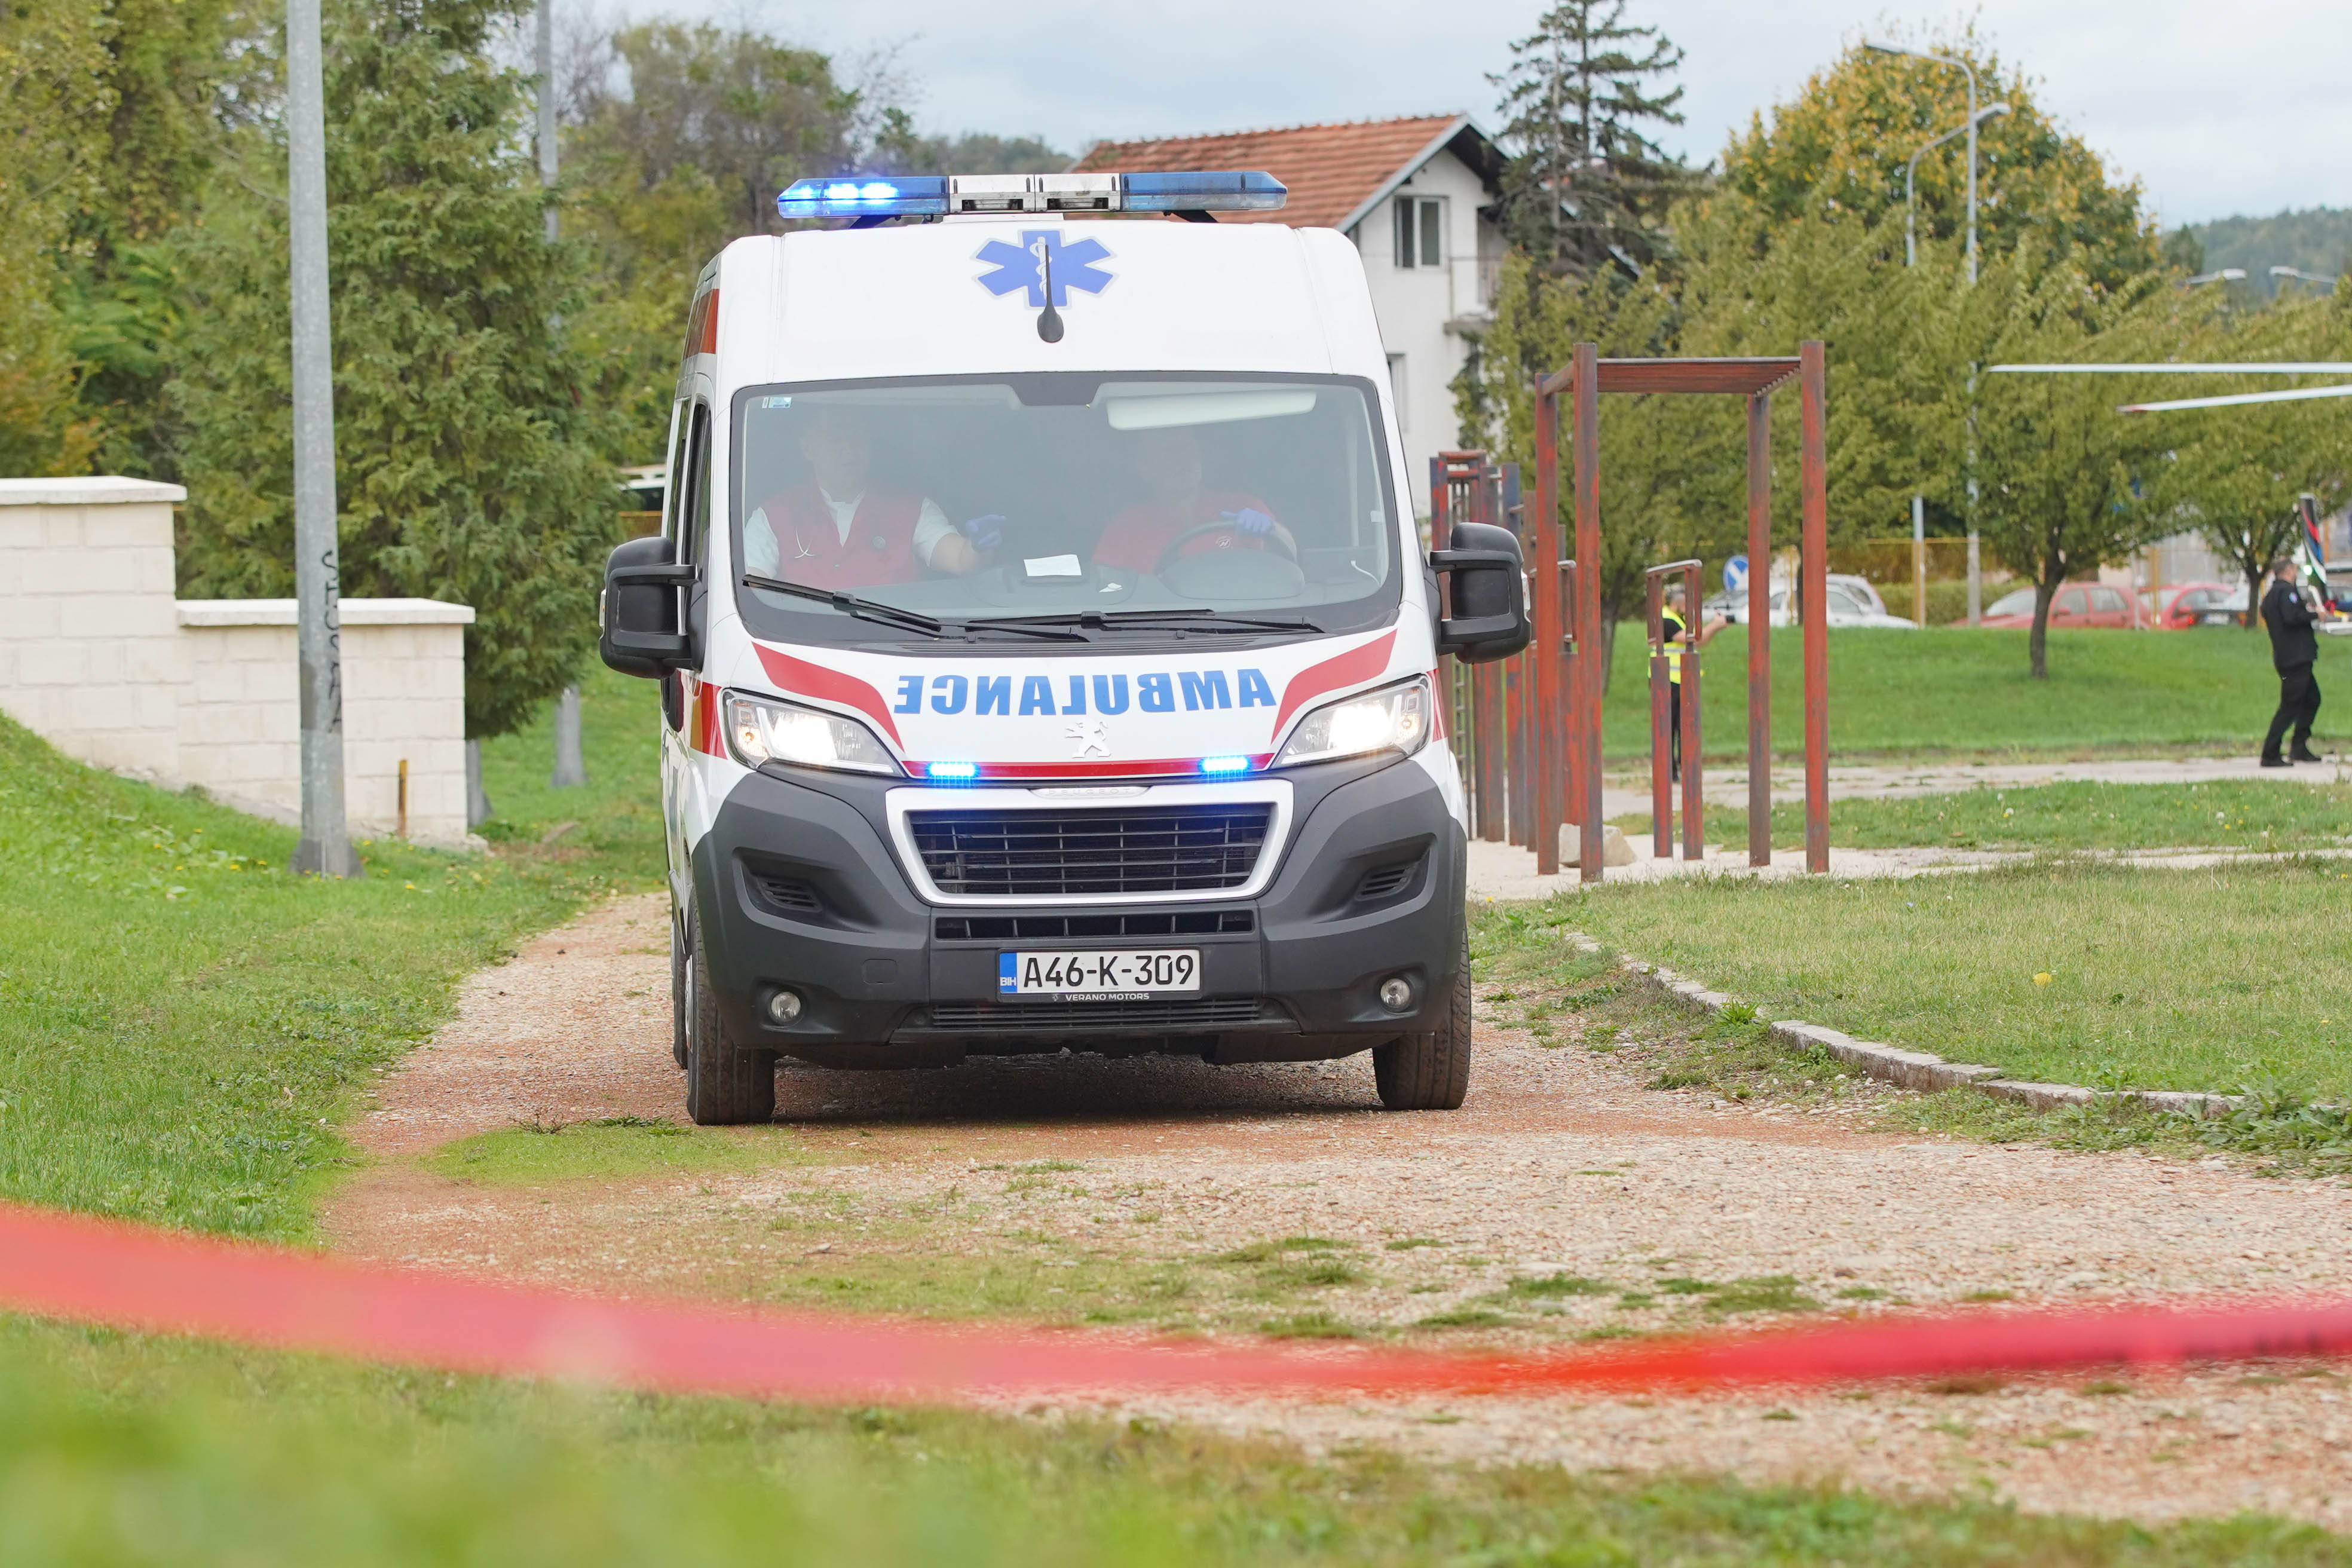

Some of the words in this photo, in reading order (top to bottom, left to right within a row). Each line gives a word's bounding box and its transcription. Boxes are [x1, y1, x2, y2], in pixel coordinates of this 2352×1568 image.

[1024, 955, 1193, 987] A46-K-309
[1000, 976, 1016, 986] BIH
[1065, 993, 1106, 1002] VERANO
